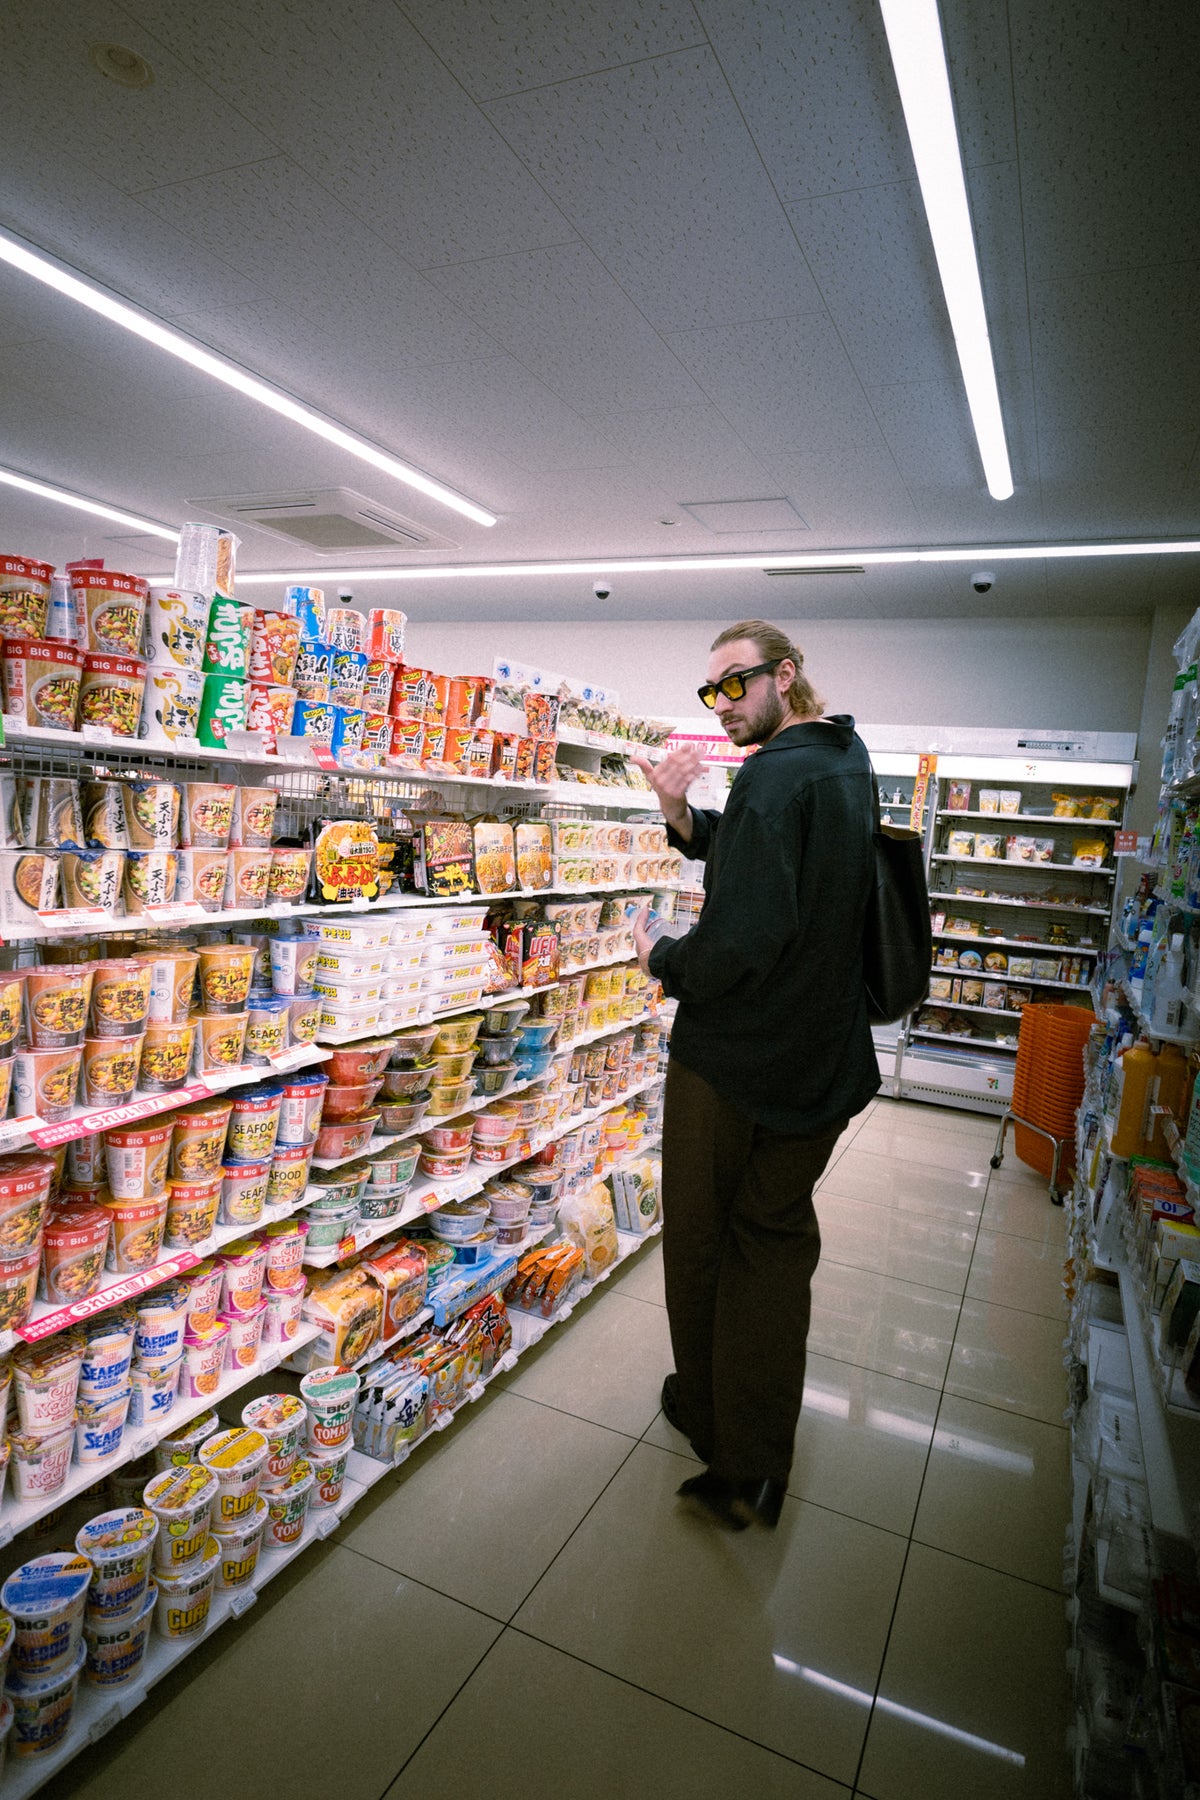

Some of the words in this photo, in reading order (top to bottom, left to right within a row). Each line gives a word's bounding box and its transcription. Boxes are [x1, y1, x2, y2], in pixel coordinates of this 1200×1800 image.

[5, 562, 25, 572] BIG
[31, 567, 46, 577] BIG
[89, 576, 107, 586] BIG
[113, 579, 130, 589] BIG
[30, 648, 50, 657] BIG
[57, 651, 73, 660] BIG
[92, 661, 110, 669] BIG
[116, 664, 133, 673] BIG
[323, 927, 351, 941] やきそば
[218, 974, 247, 984] カレー
[154, 1051, 186, 1062] カレー
[254, 1102, 268, 1110] BIG
[192, 1119, 208, 1127] BIG
[212, 1116, 224, 1125] BIG
[108, 1136, 122, 1144] BIG
[126, 1137, 144, 1145] BIG
[149, 1133, 164, 1143] BIG
[290, 1150, 303, 1158] BIG
[243, 1168, 257, 1176] BIG
[16, 1183, 35, 1193] BIG
[195, 1189, 209, 1197] BIG
[117, 1212, 134, 1220] BIG
[139, 1208, 155, 1218] BIG
[47, 1238, 65, 1247] BIG
[70, 1236, 88, 1246] BIG
[4, 1263, 23, 1274] BIG
[326, 1401, 350, 1414] BIG
[85, 1518, 124, 1535] SEAFOOD
[18, 1564, 63, 1577] SEAFOOD
[63, 1562, 87, 1570] BIG
[103, 1567, 133, 1580] BIG
[15, 1619, 49, 1630] BIG
[97, 1631, 130, 1645] BIG
